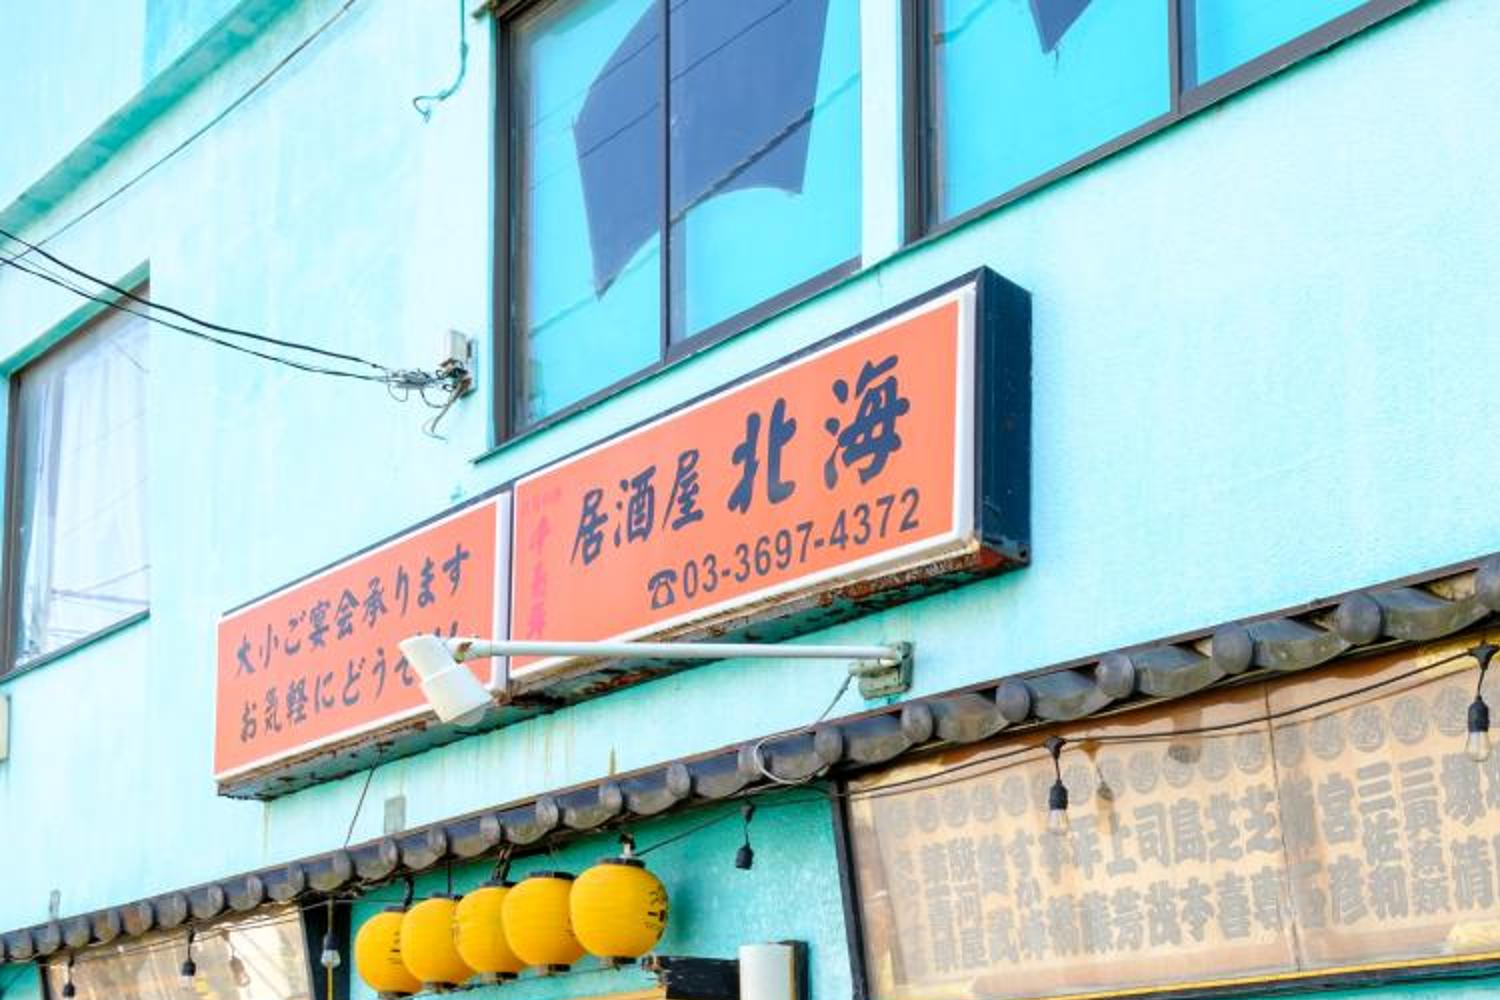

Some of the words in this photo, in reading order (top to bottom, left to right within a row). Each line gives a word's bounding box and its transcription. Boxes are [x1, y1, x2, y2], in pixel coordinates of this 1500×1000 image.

[570, 449, 704, 566] 居酒屋
[727, 355, 911, 514] 北海
[235, 543, 471, 677] 大小ご宴会承ります
[683, 487, 920, 599] 03-3697-4372
